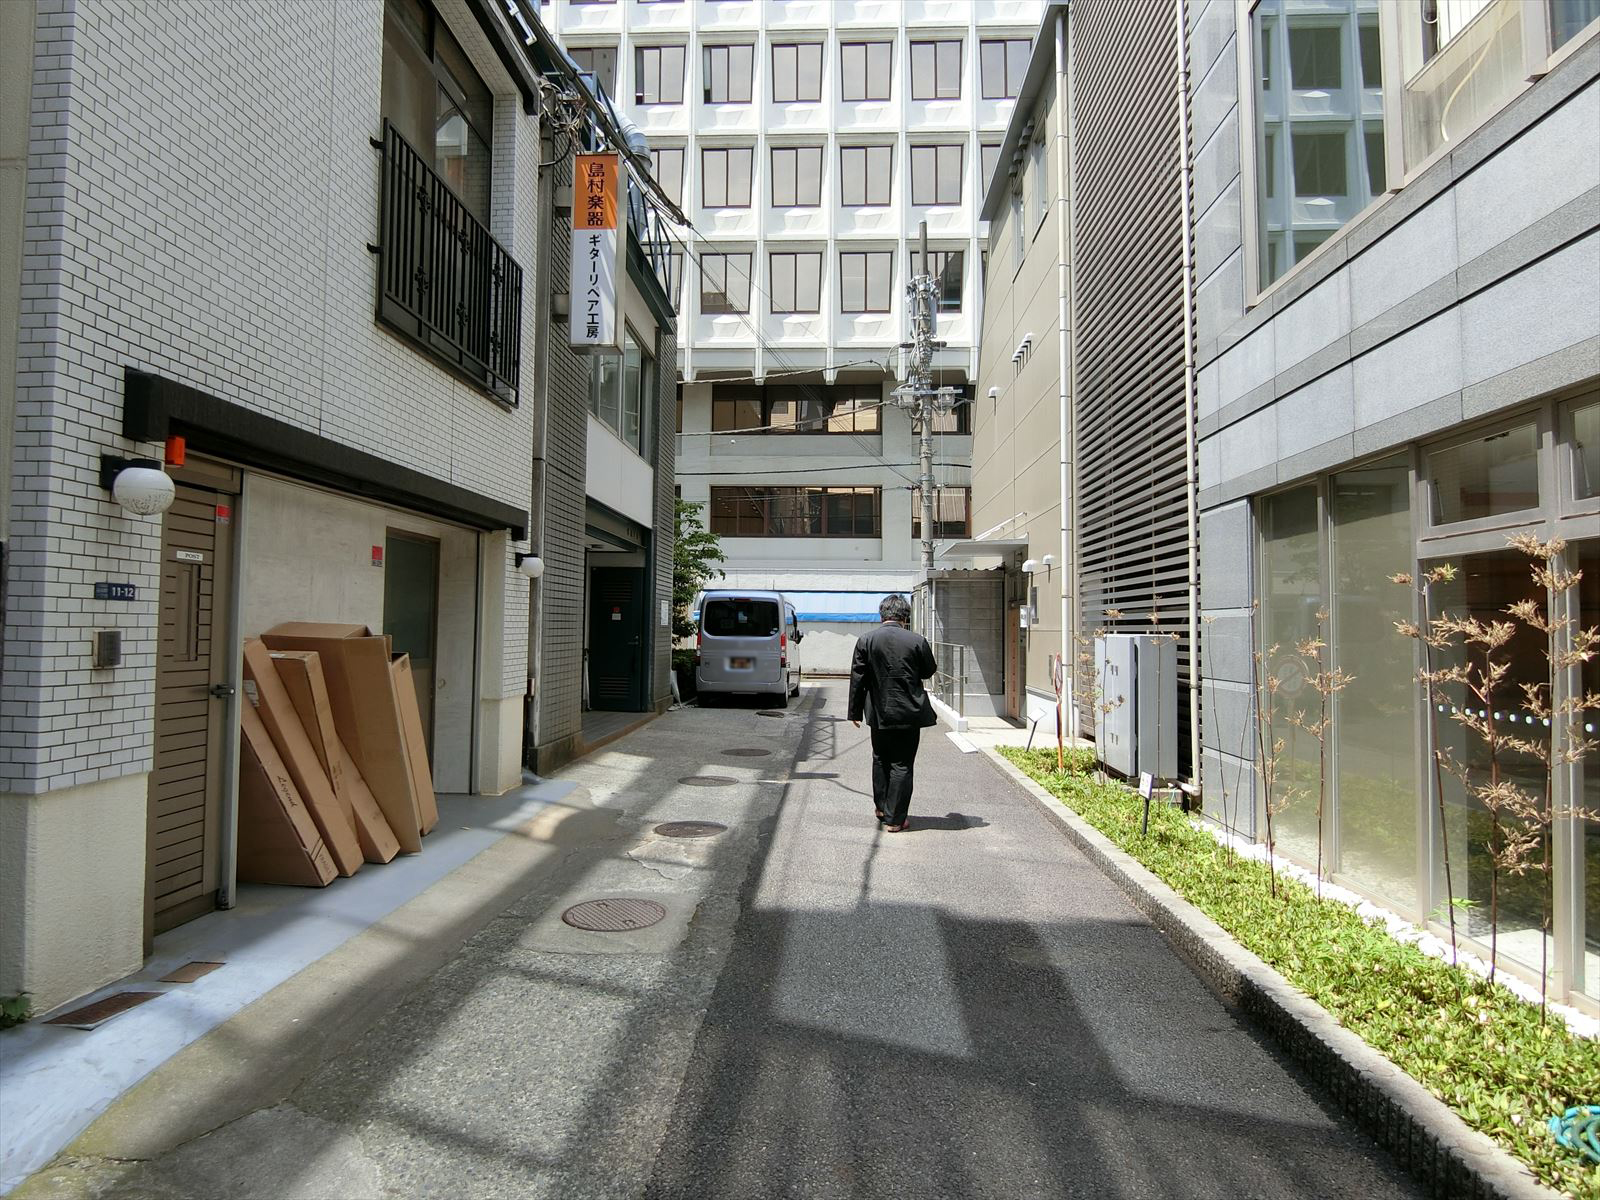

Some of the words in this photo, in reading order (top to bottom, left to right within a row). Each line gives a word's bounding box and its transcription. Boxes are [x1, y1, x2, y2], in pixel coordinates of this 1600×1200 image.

[587, 162, 605, 227] 島村楽器
[586, 234, 601, 338] ギターリペア工房
[112, 587, 134, 598] 11-12
[277, 775, 298, 808] Legend
